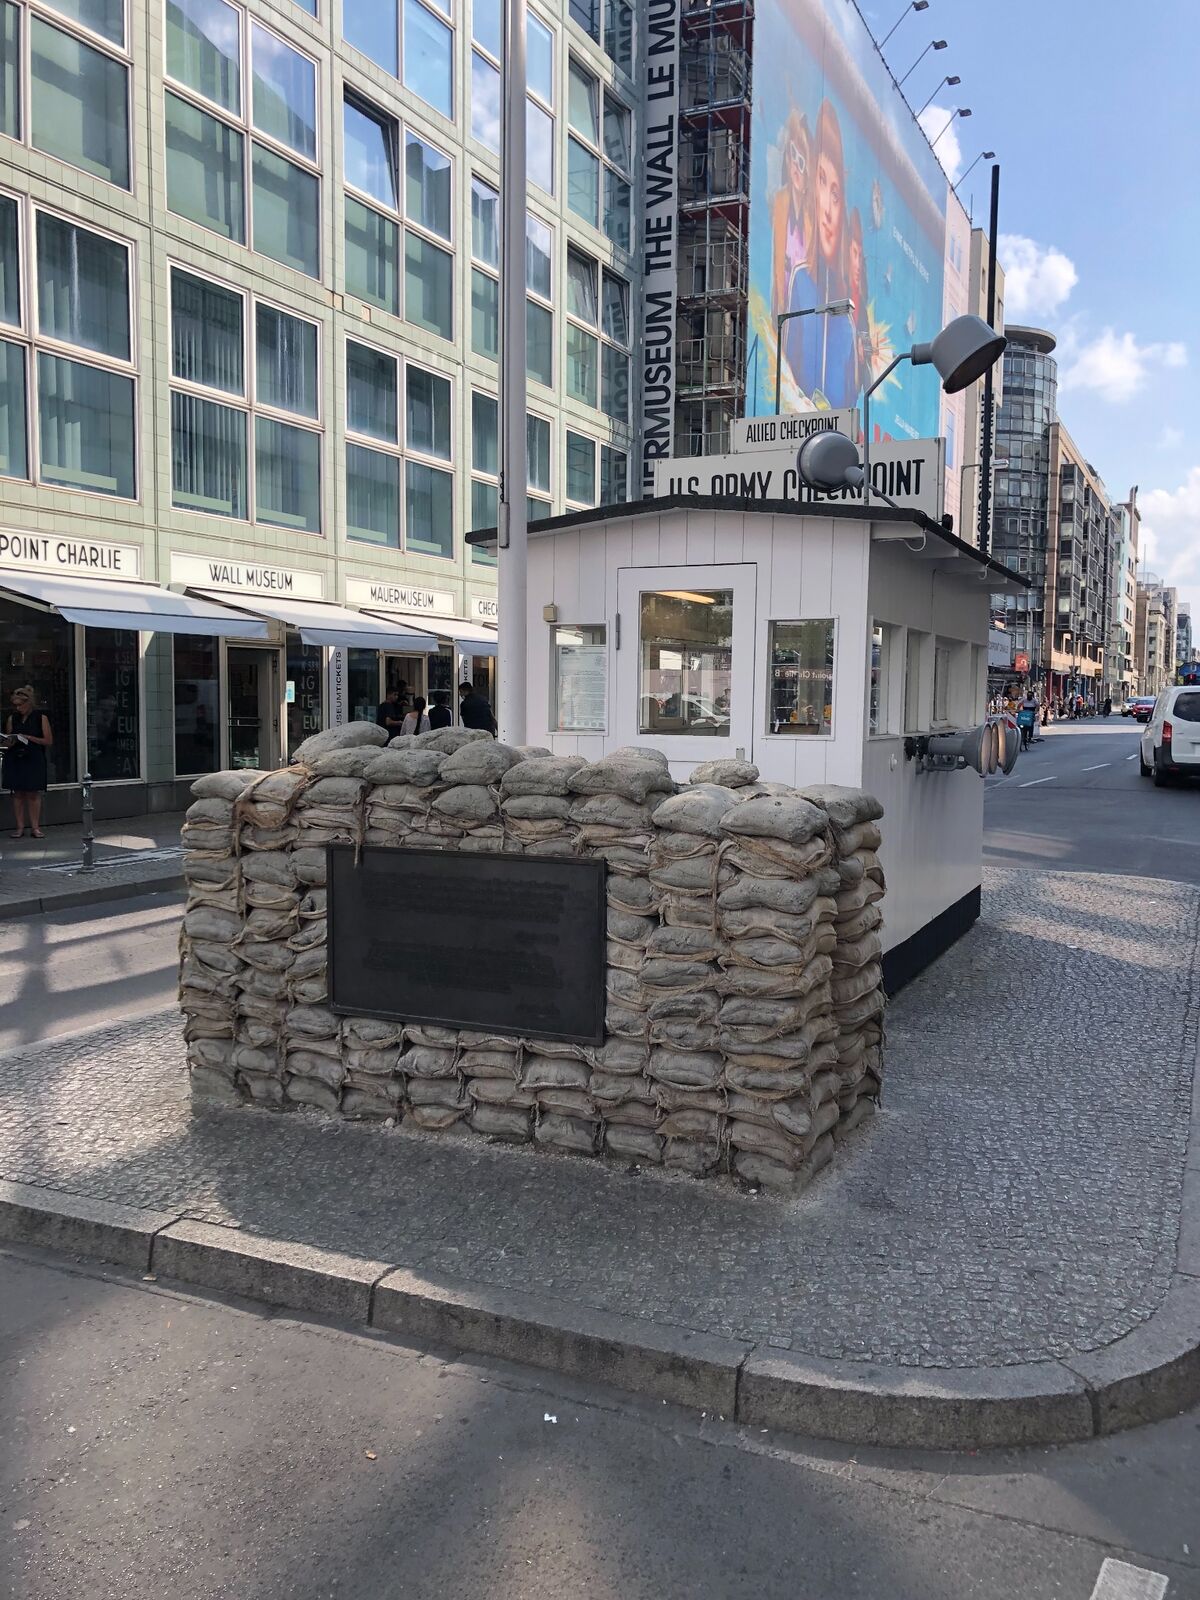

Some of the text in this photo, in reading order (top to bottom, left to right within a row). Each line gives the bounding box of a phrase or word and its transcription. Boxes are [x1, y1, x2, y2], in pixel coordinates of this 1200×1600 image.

[648, 63, 675, 101] LE
[646, 115, 675, 209] WALL
[645, 215, 673, 276] THE
[746, 416, 840, 443] ALLIED CHECKPOINT
[0, 534, 122, 570] POINT CHARLIE
[208, 563, 293, 591] WALL MUSEUM
[370, 585, 435, 609] MAUERMUSEUM
